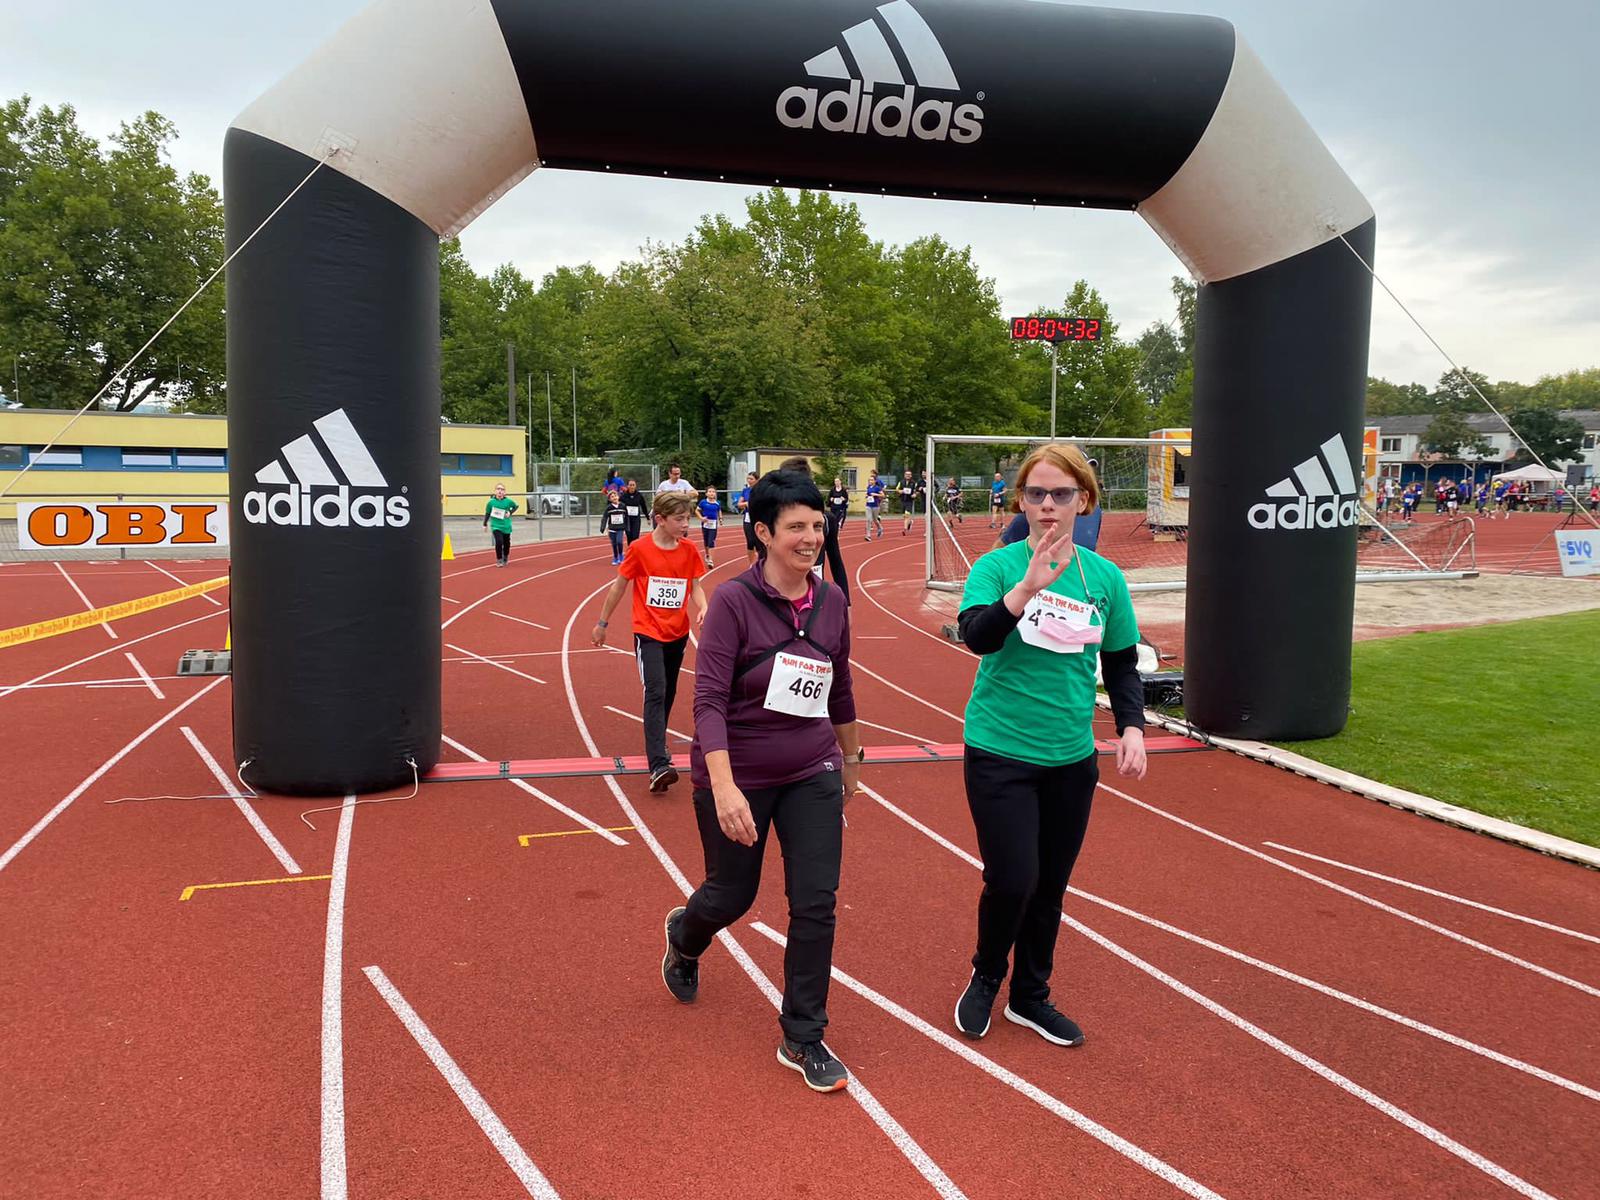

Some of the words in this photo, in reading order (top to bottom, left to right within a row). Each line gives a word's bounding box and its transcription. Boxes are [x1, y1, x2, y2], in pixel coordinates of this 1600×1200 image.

[776, 79, 984, 144] adidas
[1013, 318, 1099, 340] 08:04:32
[243, 483, 410, 528] adidas
[27, 504, 217, 547] OBI
[1566, 540, 1592, 558] SVQ
[650, 597, 681, 606] Nico
[658, 588, 678, 598] 350
[1068, 602, 1085, 613] KIDS
[798, 661, 814, 673] FOR
[789, 677, 823, 699] 466
